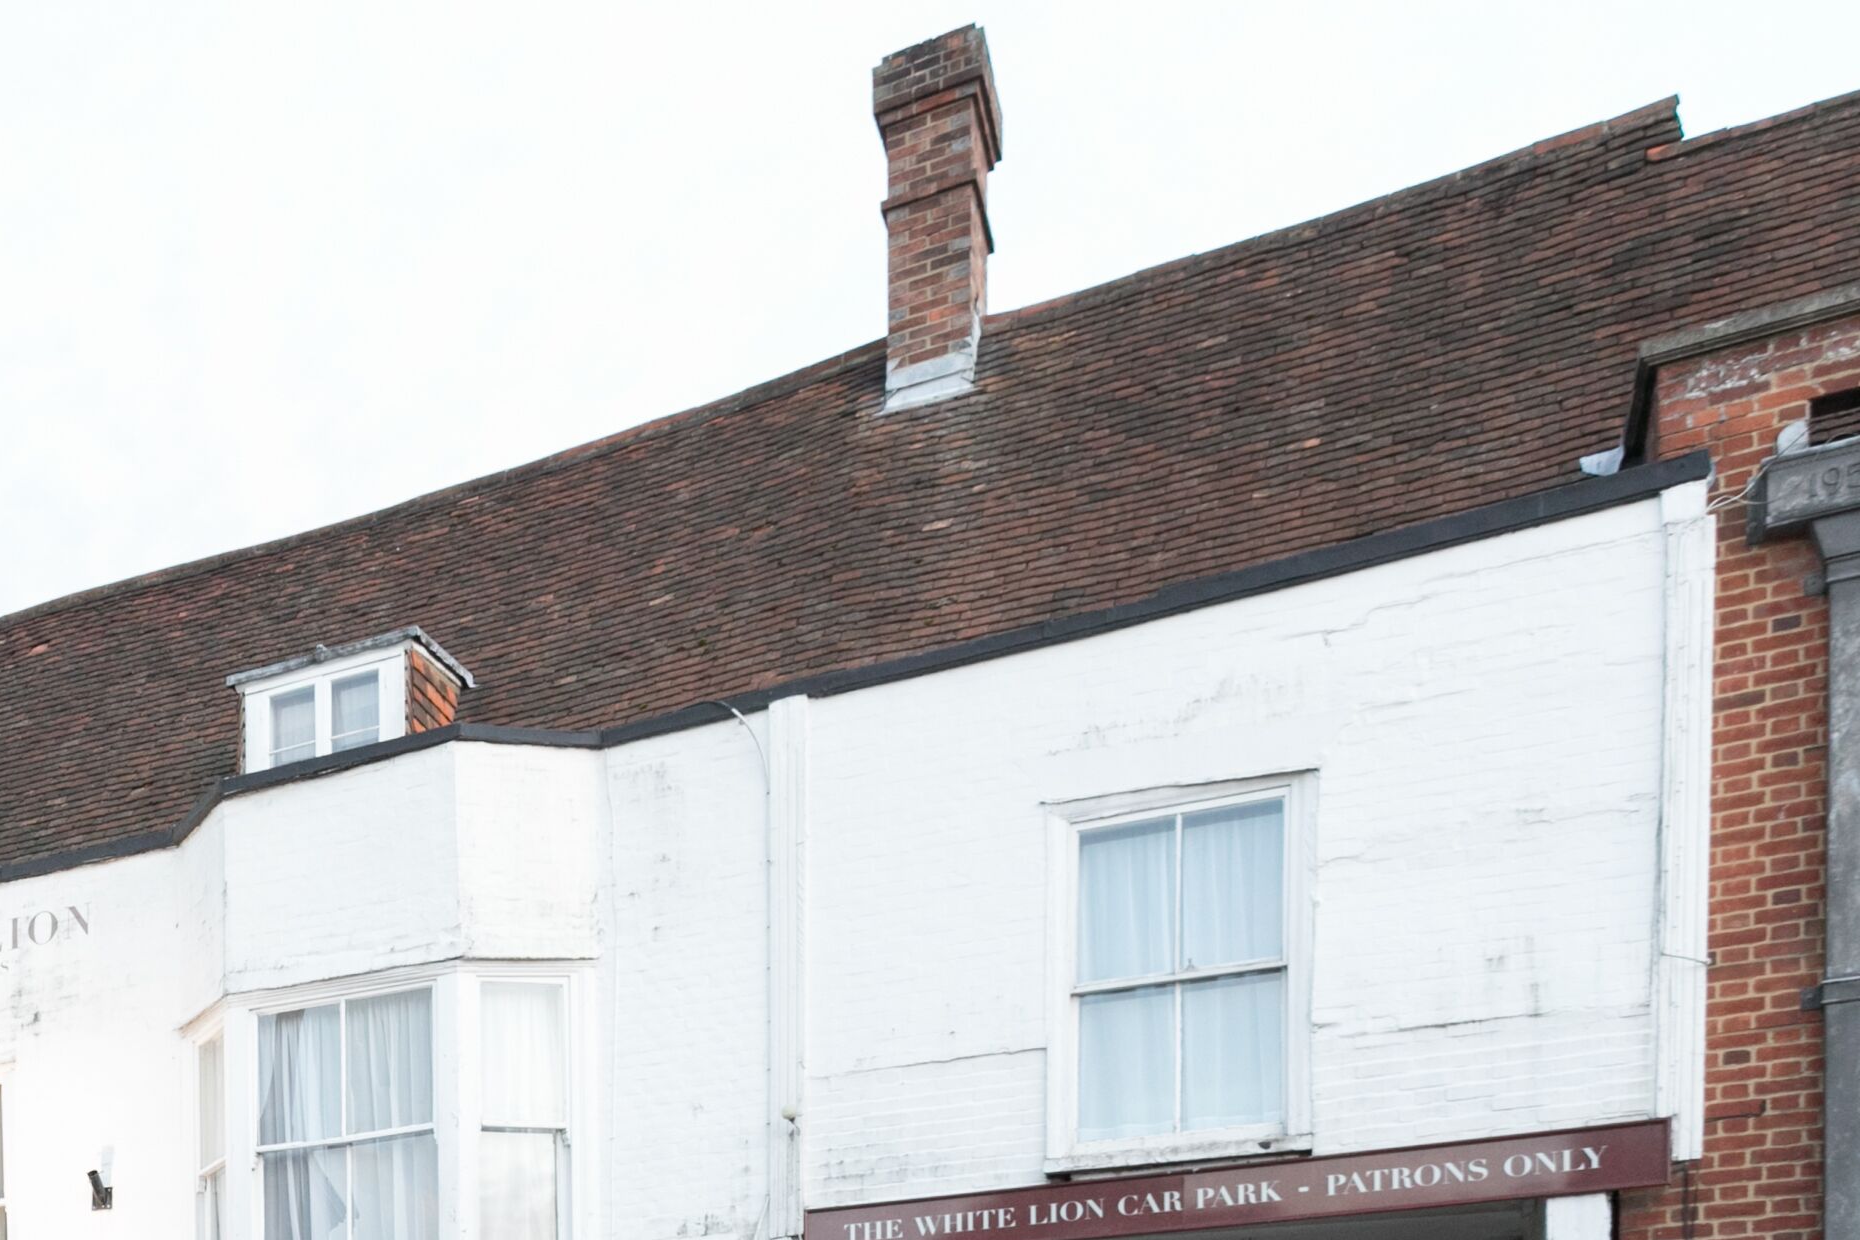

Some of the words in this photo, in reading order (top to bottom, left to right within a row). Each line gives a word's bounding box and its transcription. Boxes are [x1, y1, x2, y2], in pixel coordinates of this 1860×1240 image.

[915, 1207, 1017, 1238] WHITE
[1028, 1198, 1106, 1227] LION
[1117, 1190, 1183, 1216] CAR
[1196, 1179, 1284, 1209] PARK
[1325, 1158, 1489, 1197] PATRONS
[1502, 1144, 1608, 1178] ONLY
